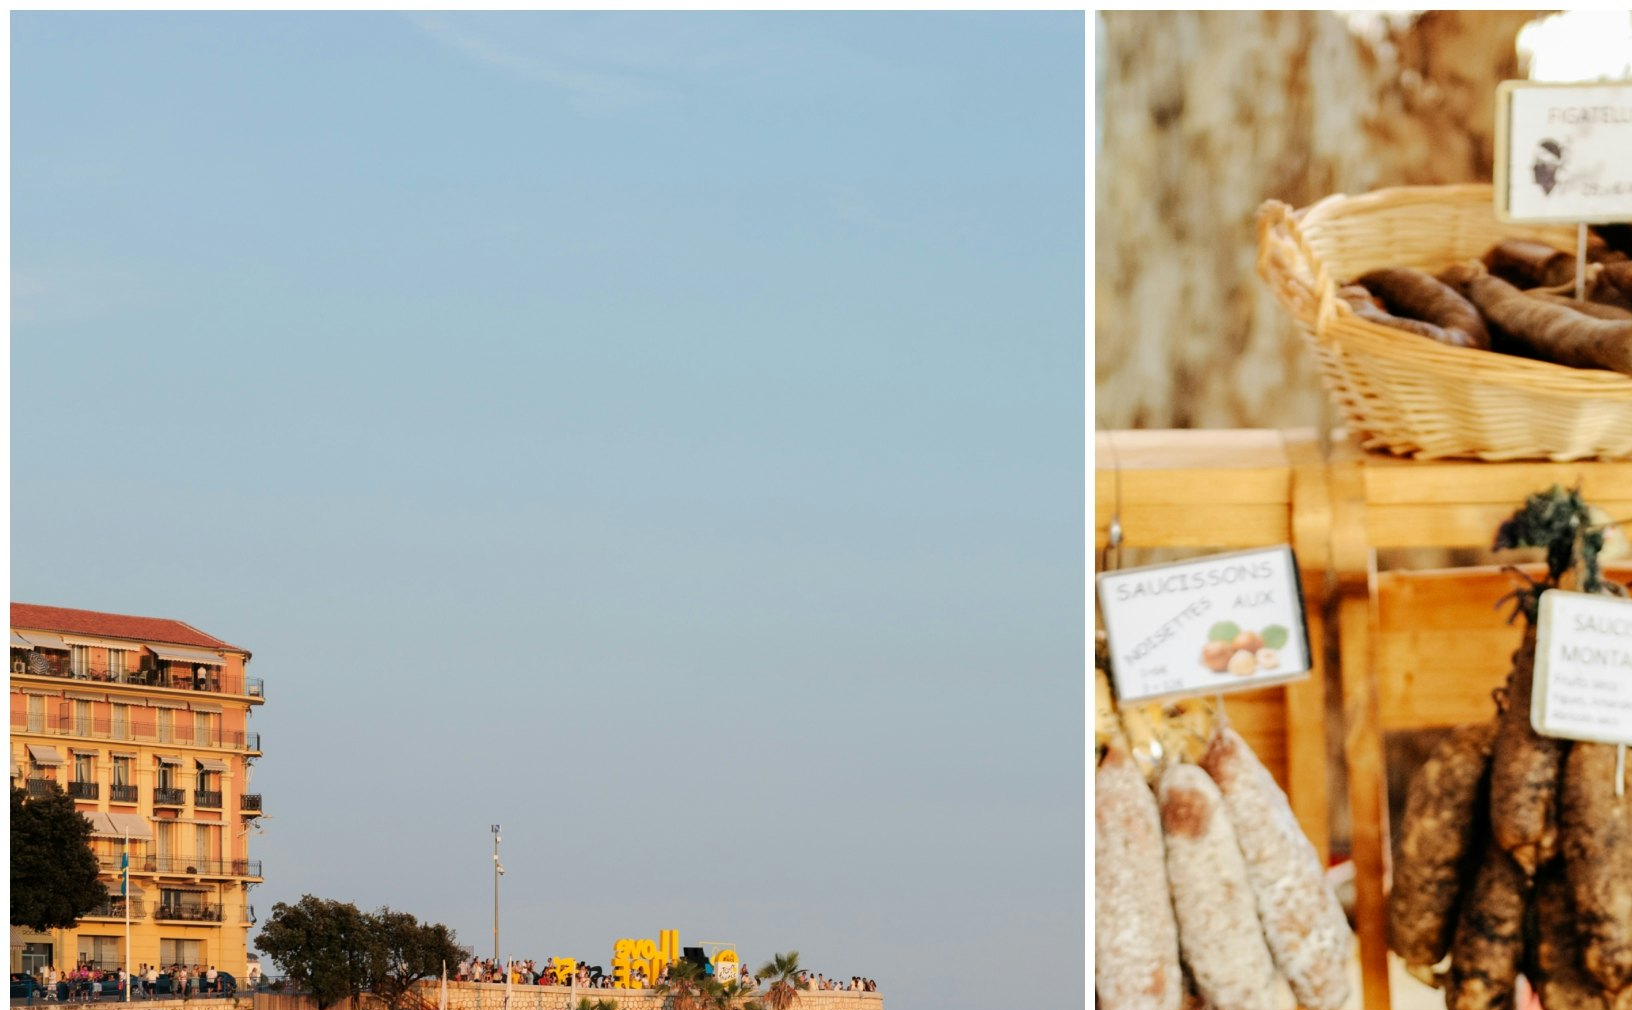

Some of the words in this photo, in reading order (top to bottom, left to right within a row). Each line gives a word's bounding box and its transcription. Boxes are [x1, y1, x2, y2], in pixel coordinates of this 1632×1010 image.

[1116, 561, 1273, 601] SAUCISSONS
[1232, 590, 1275, 609] AUX
[1124, 597, 1212, 665] NOISETTES
